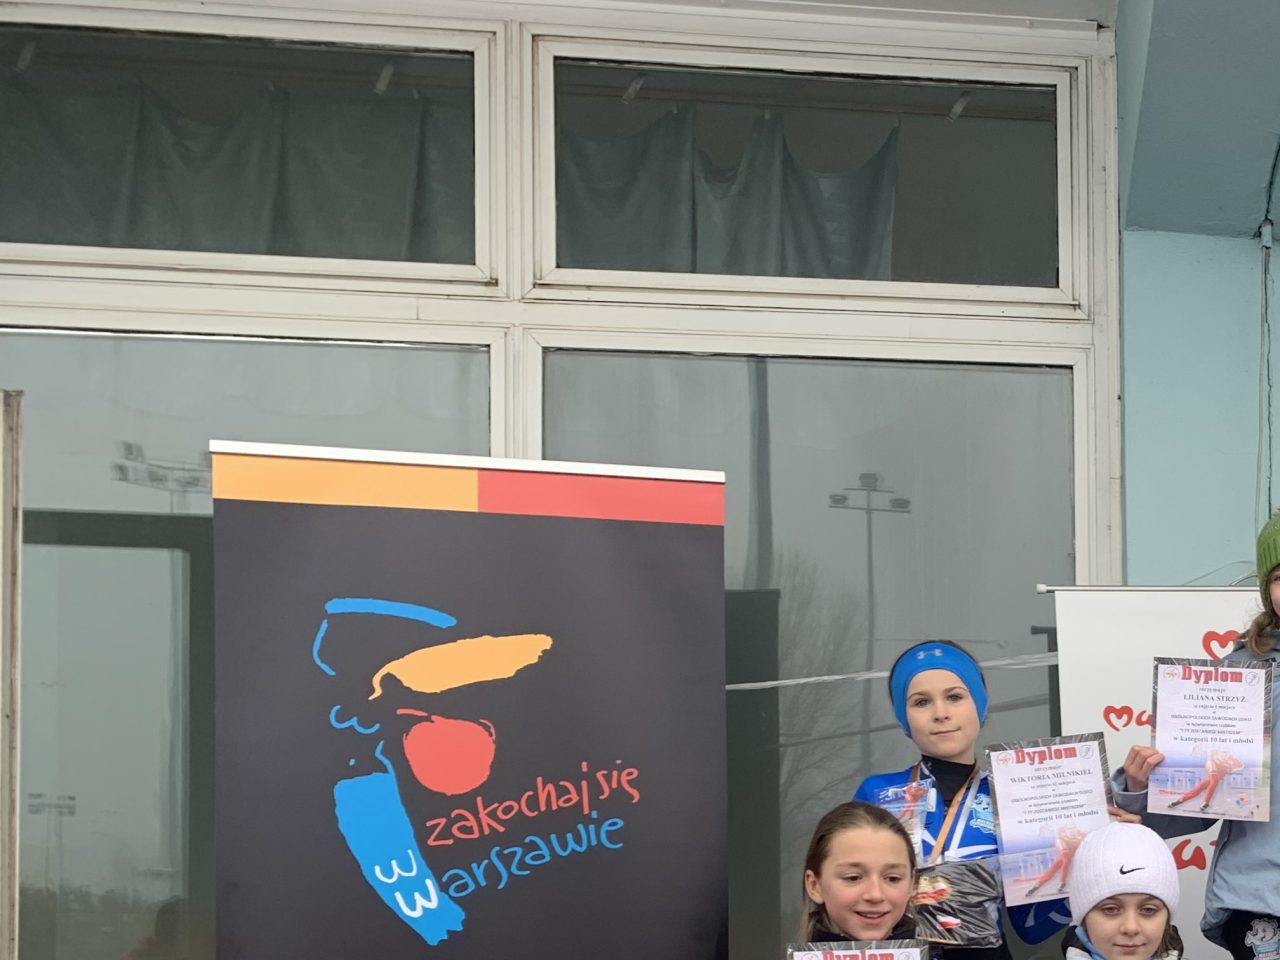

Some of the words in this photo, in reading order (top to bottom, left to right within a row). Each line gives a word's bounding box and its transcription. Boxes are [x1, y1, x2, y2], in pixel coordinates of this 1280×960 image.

[1182, 666, 1243, 684] Dyplom
[1015, 747, 1077, 765] Dyplom
[1010, 775, 1050, 783] WIKTORIA
[426, 762, 590, 846] zakochaj
[595, 760, 640, 803] się
